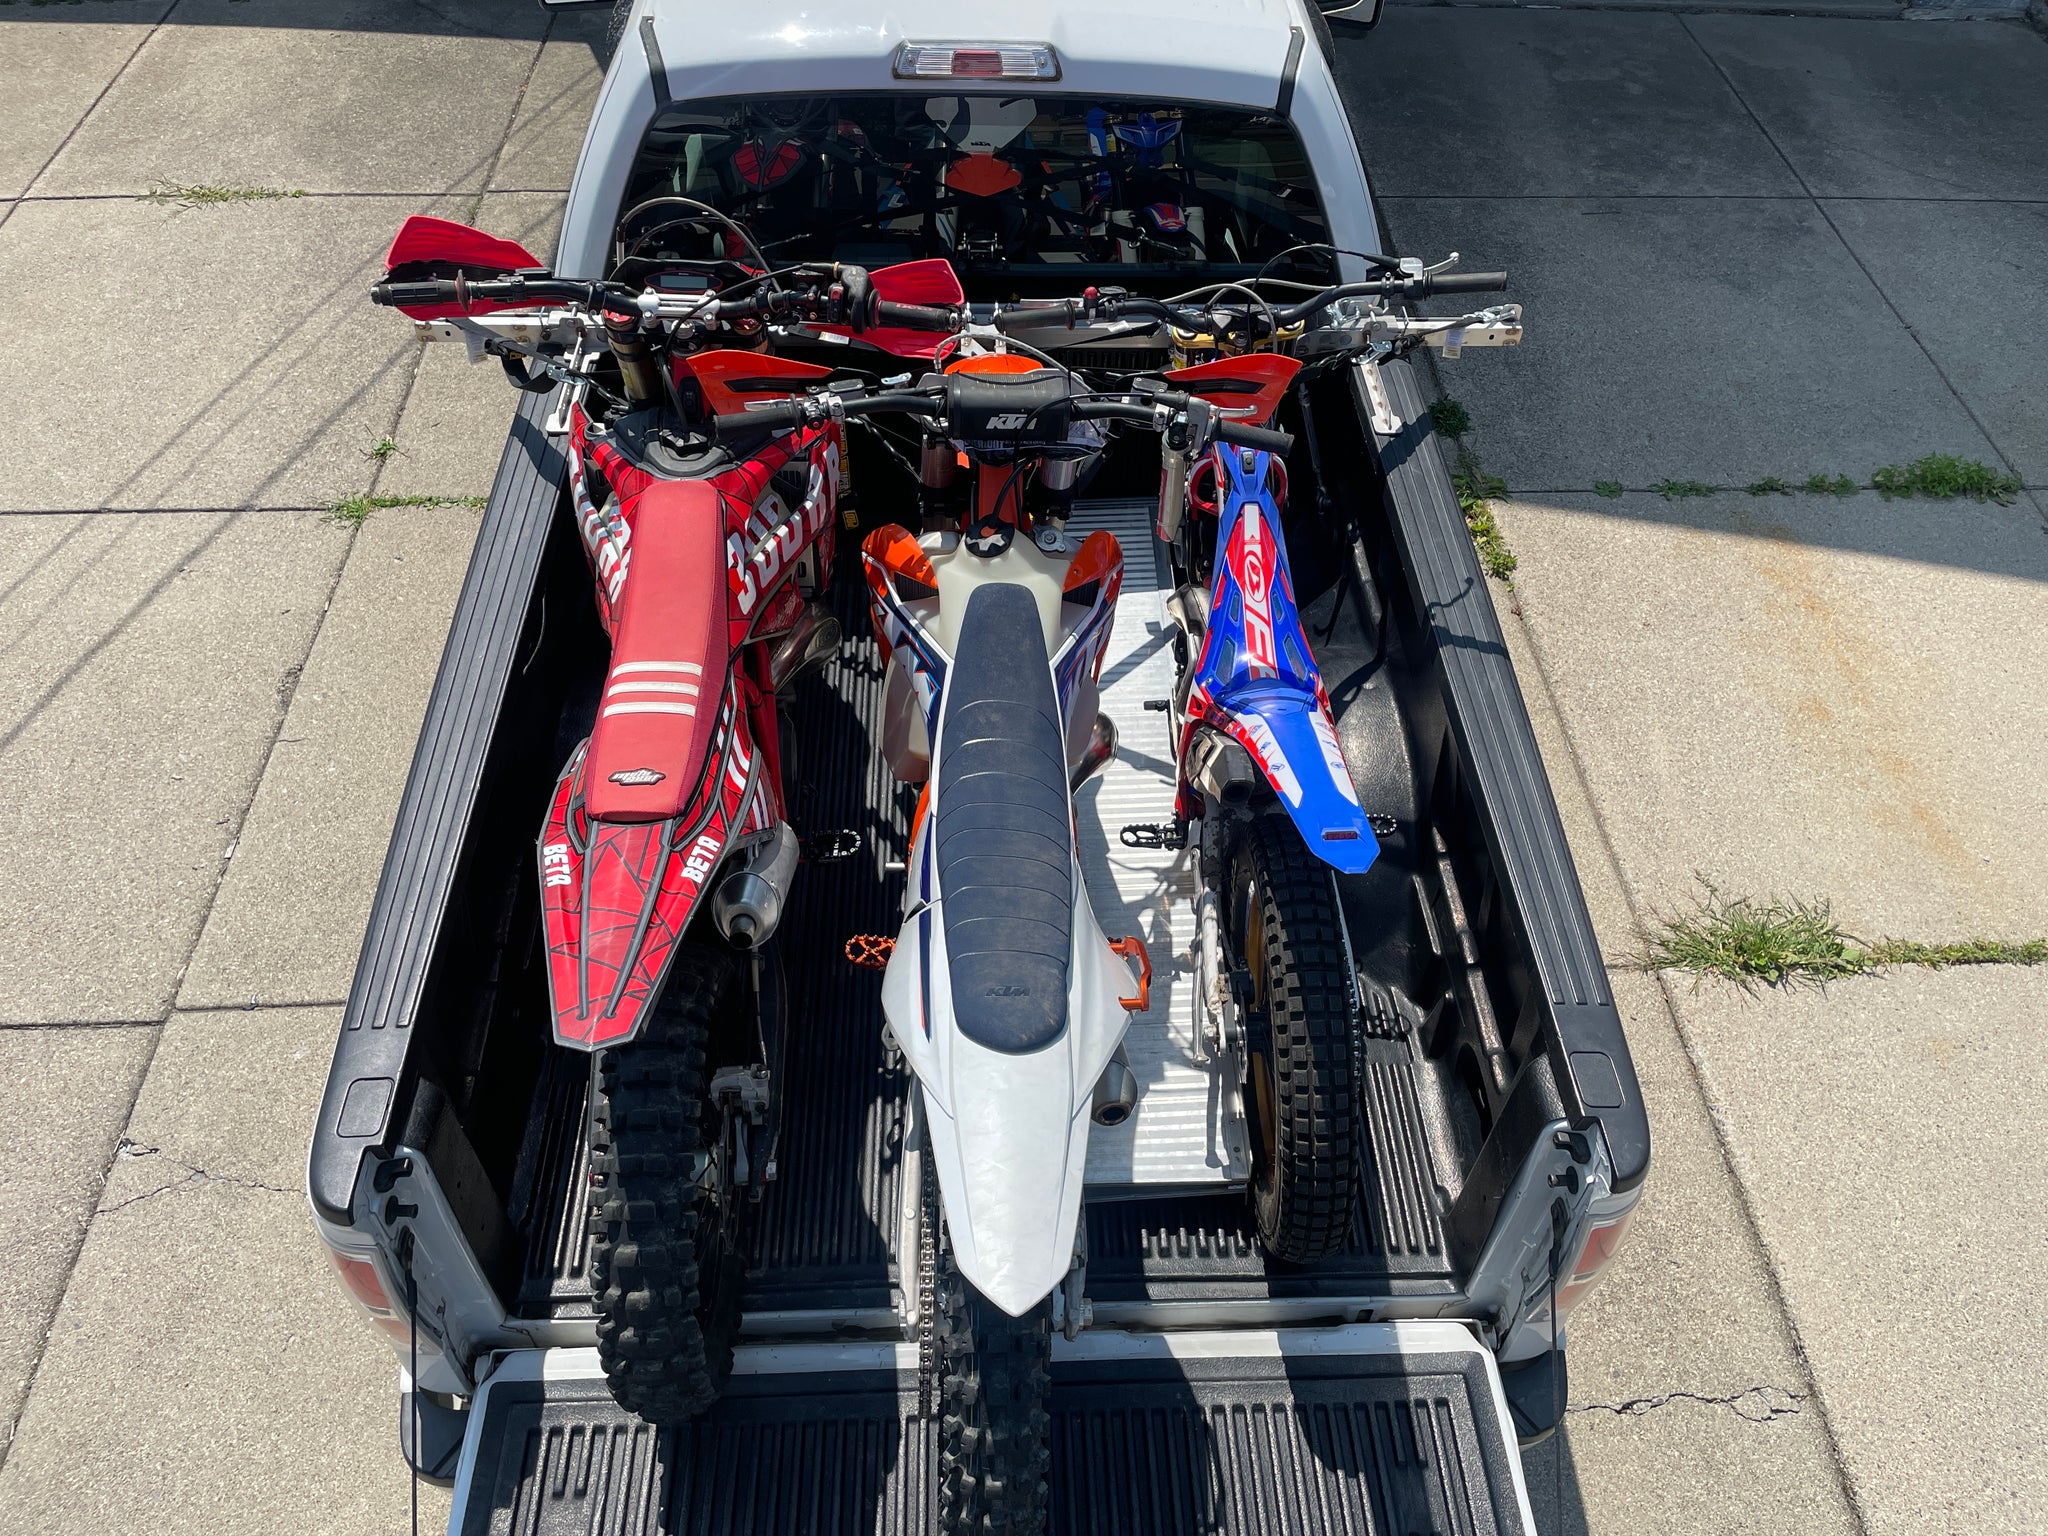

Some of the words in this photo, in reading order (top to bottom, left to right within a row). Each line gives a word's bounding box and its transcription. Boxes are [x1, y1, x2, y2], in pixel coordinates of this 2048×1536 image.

[543, 844, 572, 887] BETA
[681, 835, 721, 884] BETA
[984, 985, 1030, 998] KTM
